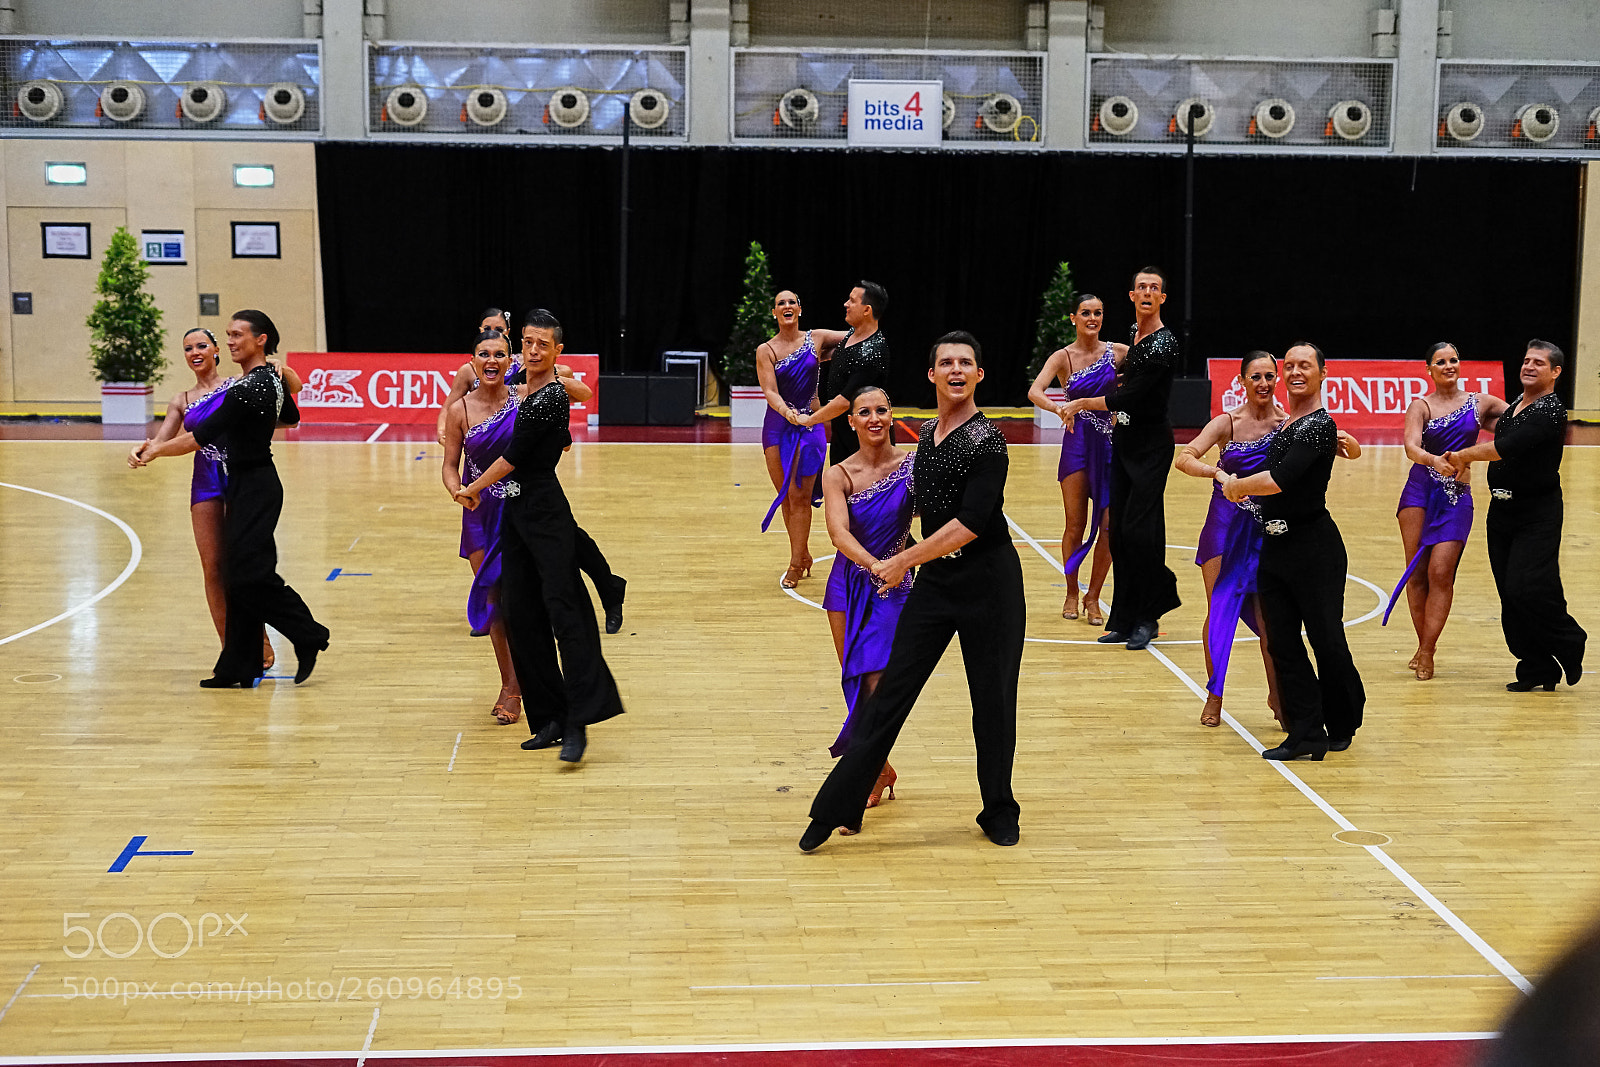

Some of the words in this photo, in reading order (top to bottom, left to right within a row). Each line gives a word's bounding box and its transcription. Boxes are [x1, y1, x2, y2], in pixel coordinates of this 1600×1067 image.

[864, 99, 900, 116] bits
[904, 91, 923, 117] 4
[864, 114, 924, 131] media
